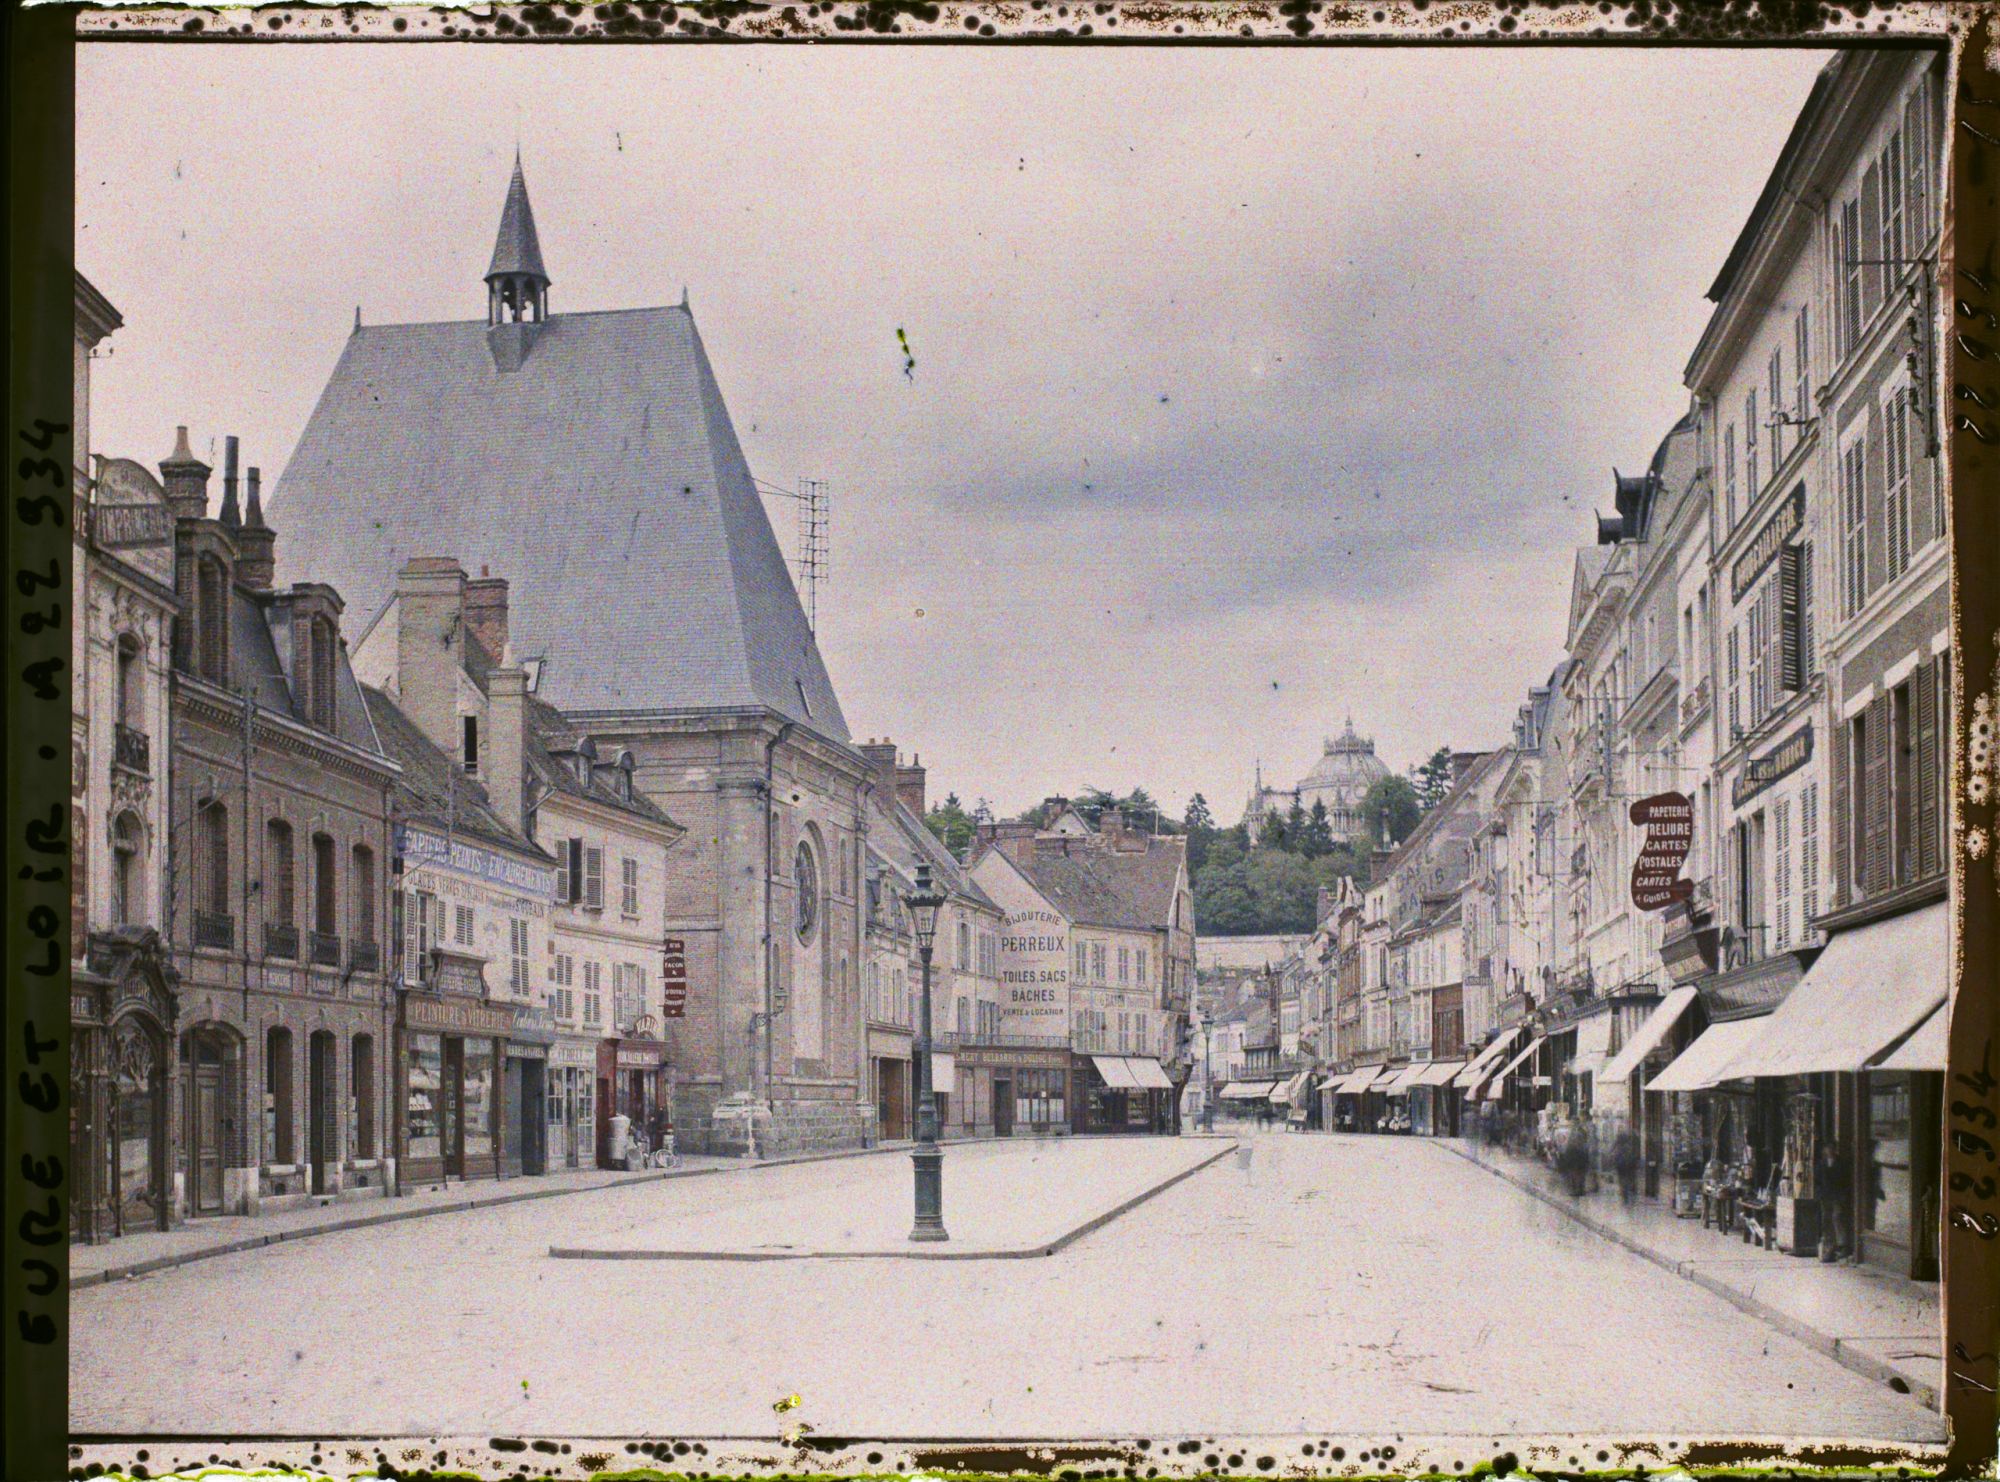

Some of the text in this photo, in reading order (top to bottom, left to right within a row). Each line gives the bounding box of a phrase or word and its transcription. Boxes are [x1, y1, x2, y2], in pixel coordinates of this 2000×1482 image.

[1649, 806, 1690, 818] PAPETERIE
[1649, 822, 1691, 836] RELIURE
[405, 830, 448, 862] PAPIERS
[449, 842, 483, 874] PEINTS
[1646, 840, 1689, 851] CARTES
[1639, 855, 1683, 870] POSTALES
[1636, 876, 1672, 887] CARTES
[1643, 890, 1671, 903] GUIDES
[1005, 911, 1062, 927] BIJOUTERIE
[1001, 935, 1065, 952] PERREUX
[1040, 970, 1067, 983] SACS
[415, 1001, 459, 1027] PEINTURE
[468, 1007, 505, 1030] VITRERIE
[1031, 1008, 1064, 1016] LOCATION
[18, 1020, 60, 1113] ET
[18, 1152, 64, 1345] EURE
